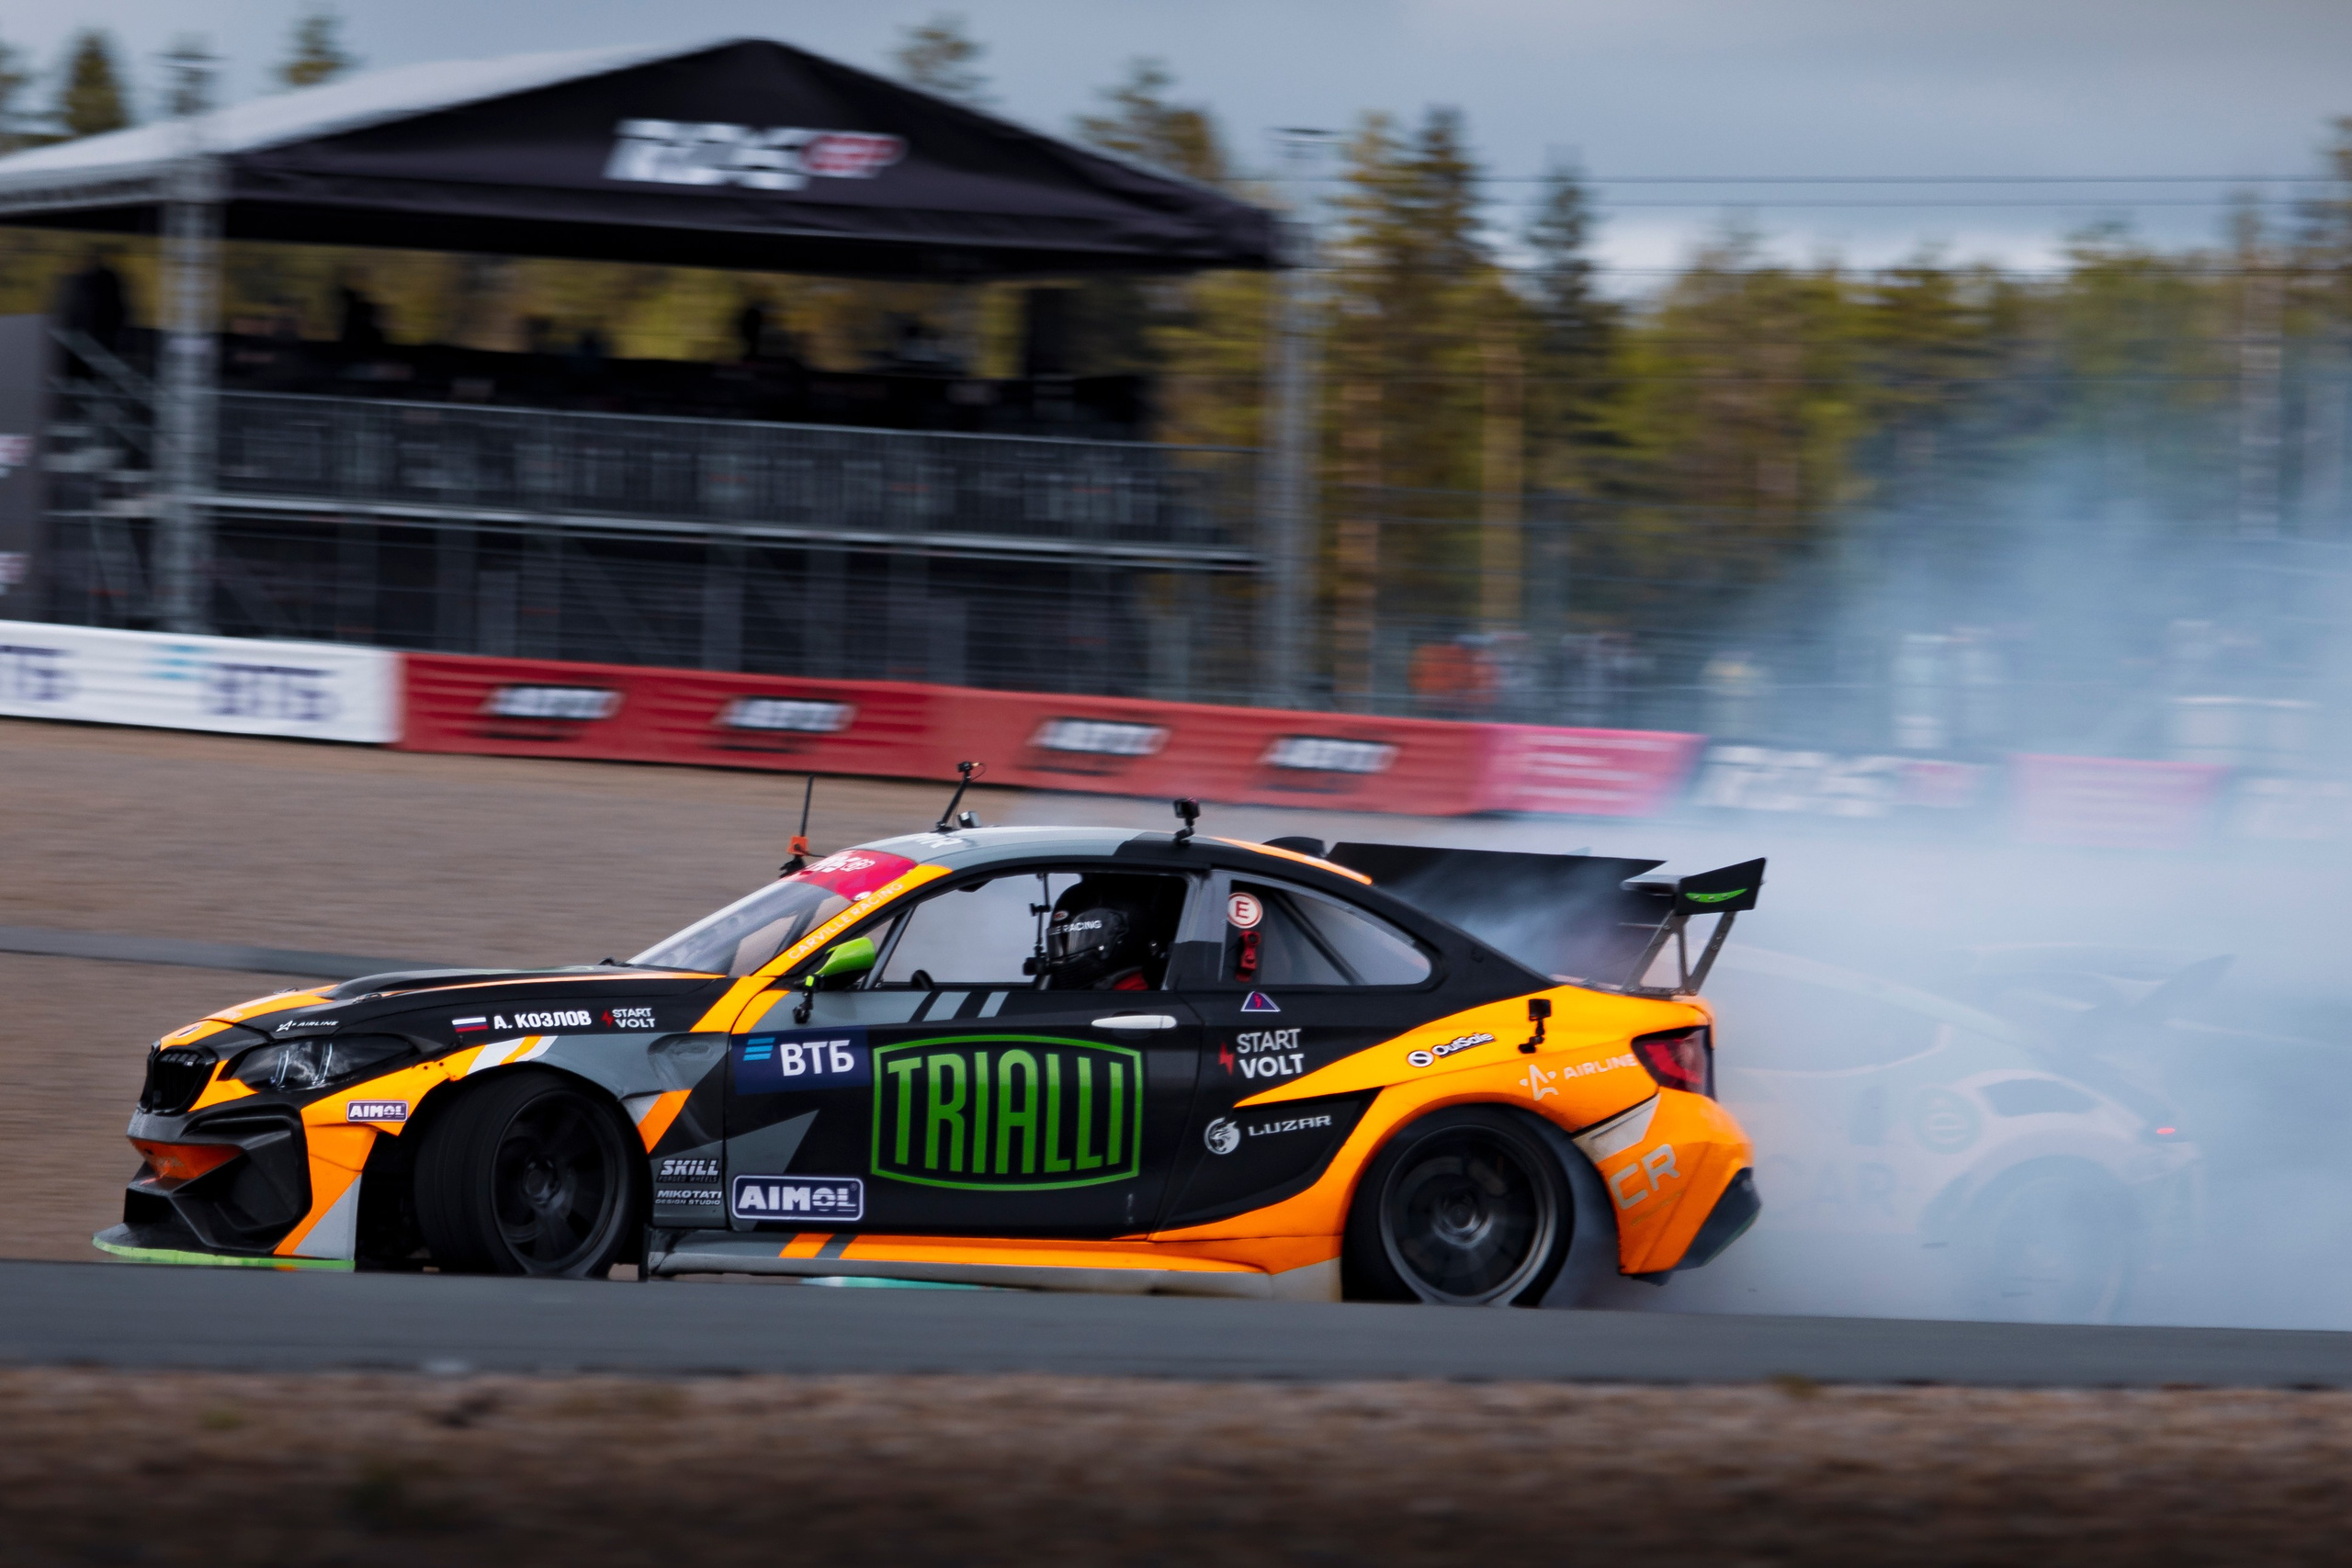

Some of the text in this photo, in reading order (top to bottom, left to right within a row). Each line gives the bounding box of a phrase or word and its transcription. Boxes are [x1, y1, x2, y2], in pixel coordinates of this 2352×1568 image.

[787, 883, 904, 960] CARVILLE RACING
[1062, 919, 1102, 933] RACING
[297, 1020, 340, 1028] AIRLINE
[493, 1010, 593, 1030] А. КОЗЛОВ
[611, 1007, 652, 1018] START
[615, 1017, 656, 1028] VOLT
[1236, 1028, 1302, 1055] START
[780, 1039, 855, 1077] ВТБ
[1238, 1053, 1305, 1078] VOLT
[1563, 1053, 1638, 1080] AIRLINE
[349, 1104, 405, 1119] AIMOL
[887, 1048, 1124, 1176] TRIALLI
[1248, 1114, 1332, 1137] LUZAR
[660, 1159, 718, 1176] SKILL
[1609, 1143, 1680, 1211] CR
[657, 1190, 723, 1199] MIKOTATI
[738, 1185, 857, 1212] AIMOL
